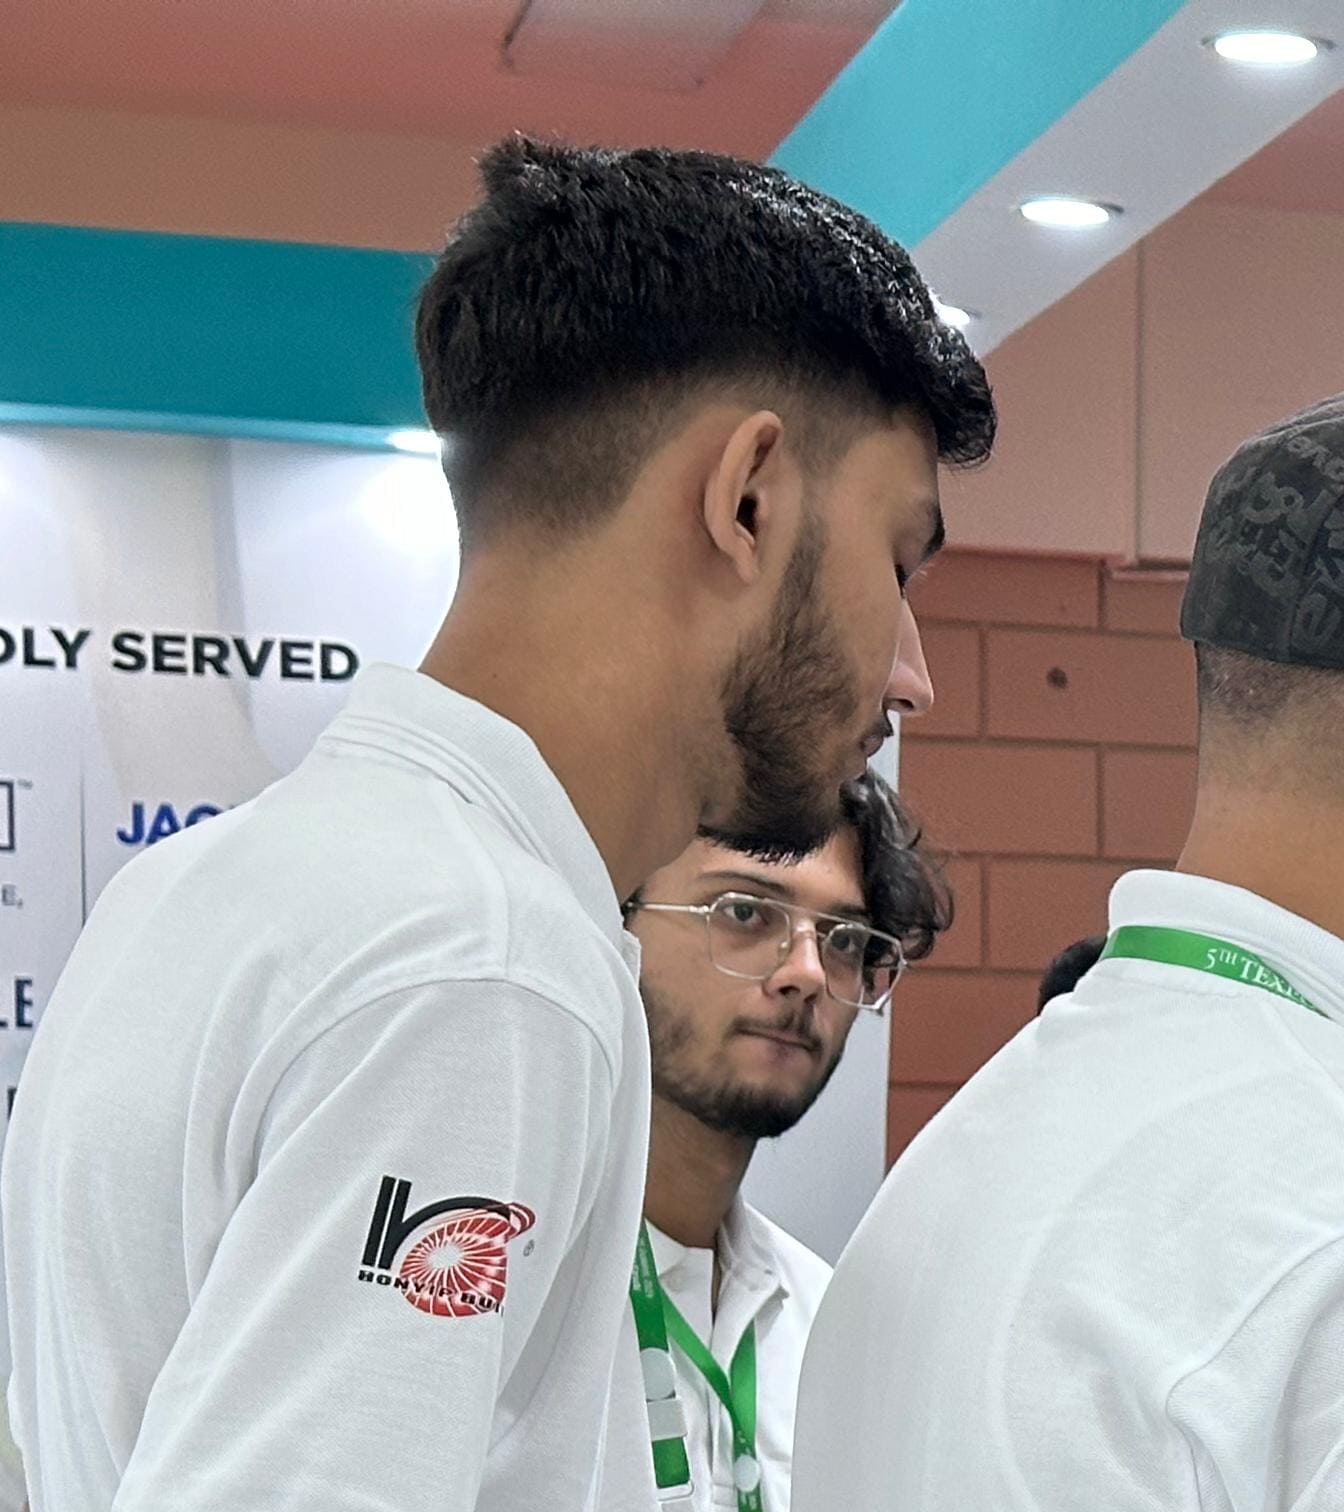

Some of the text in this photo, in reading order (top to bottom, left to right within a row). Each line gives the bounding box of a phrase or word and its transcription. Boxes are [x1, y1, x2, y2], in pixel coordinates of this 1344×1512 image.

[112, 630, 361, 683] SERVED
[1239, 957, 1313, 1007] TEX
[357, 1269, 457, 1299] HONYIP
